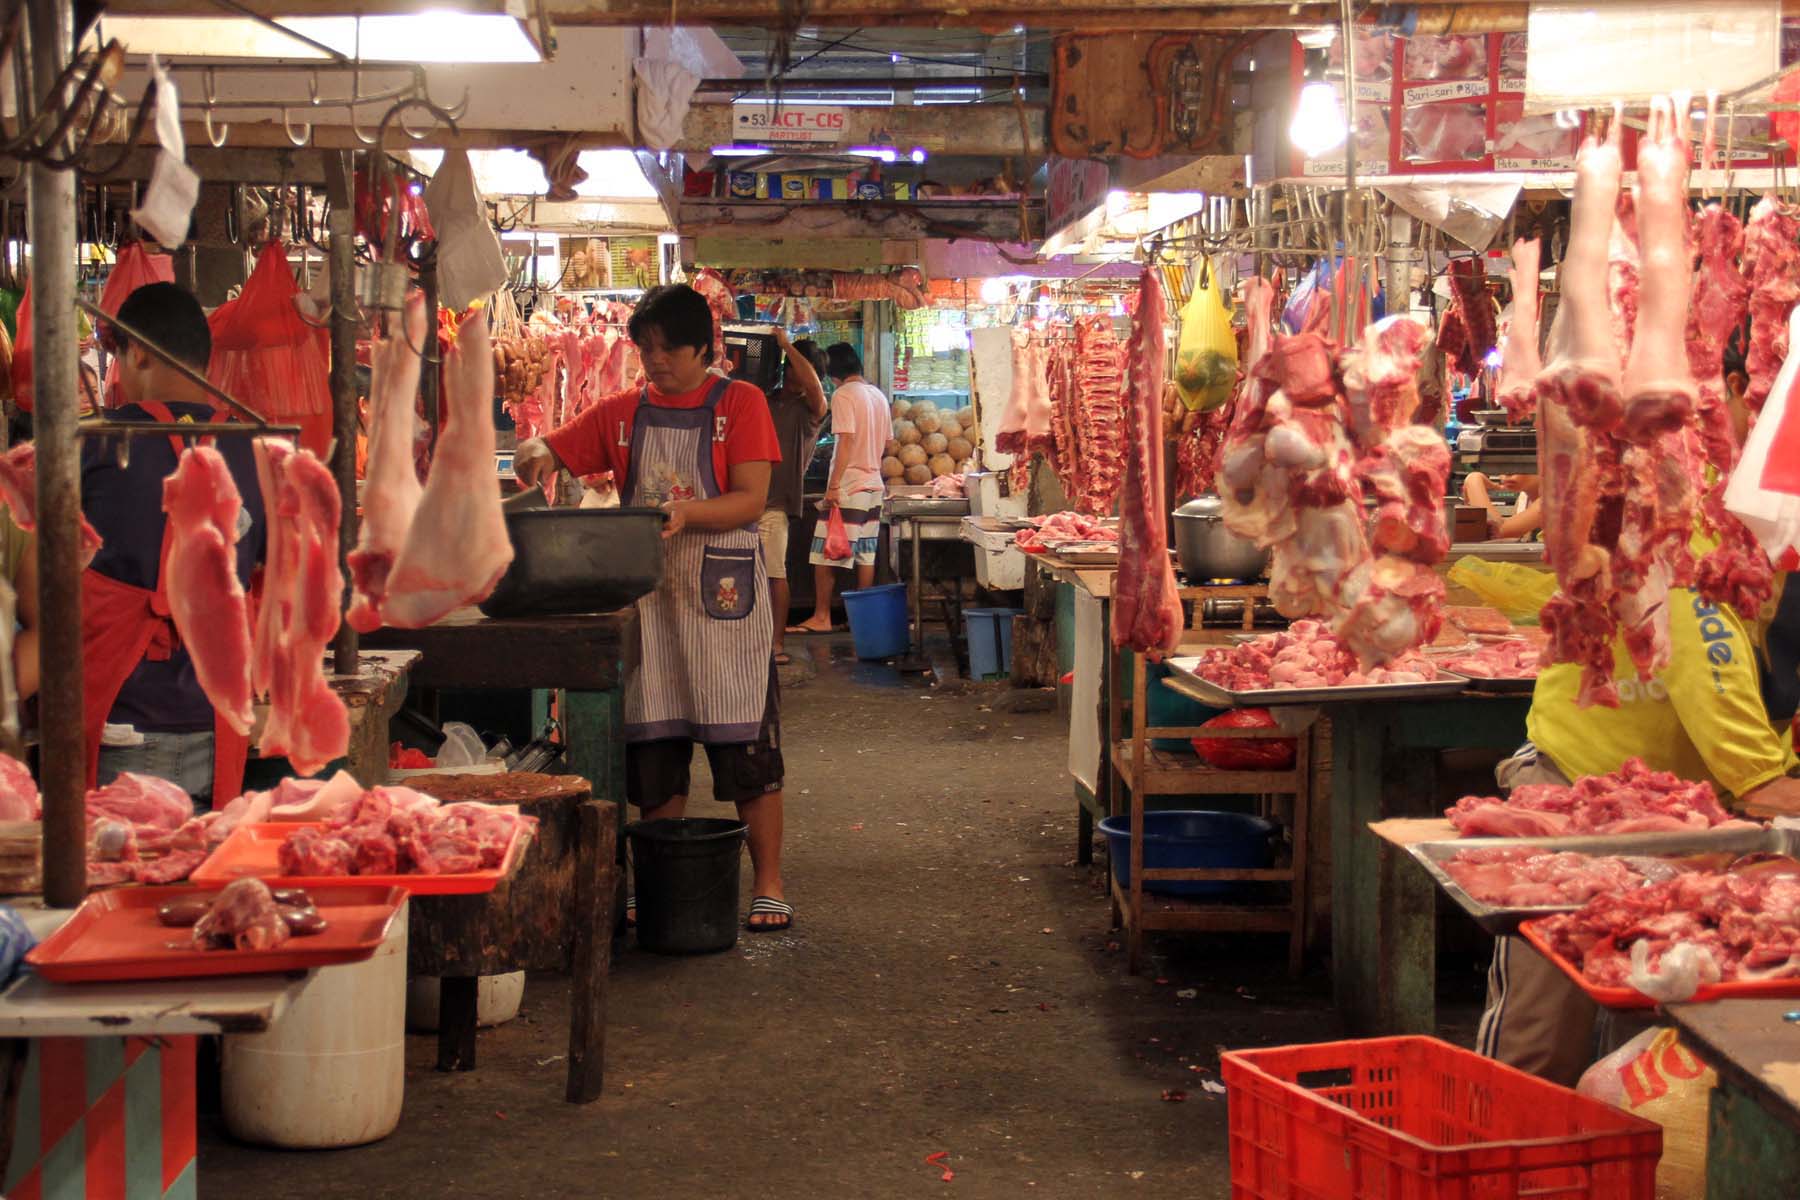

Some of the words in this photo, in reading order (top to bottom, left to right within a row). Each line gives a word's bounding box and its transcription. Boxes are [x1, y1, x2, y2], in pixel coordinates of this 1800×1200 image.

[1500, 79, 1526, 89] Mask
[1407, 86, 1453, 102] Sari-sari
[751, 114, 766, 126] 53
[771, 112, 844, 128] ACT-CIS
